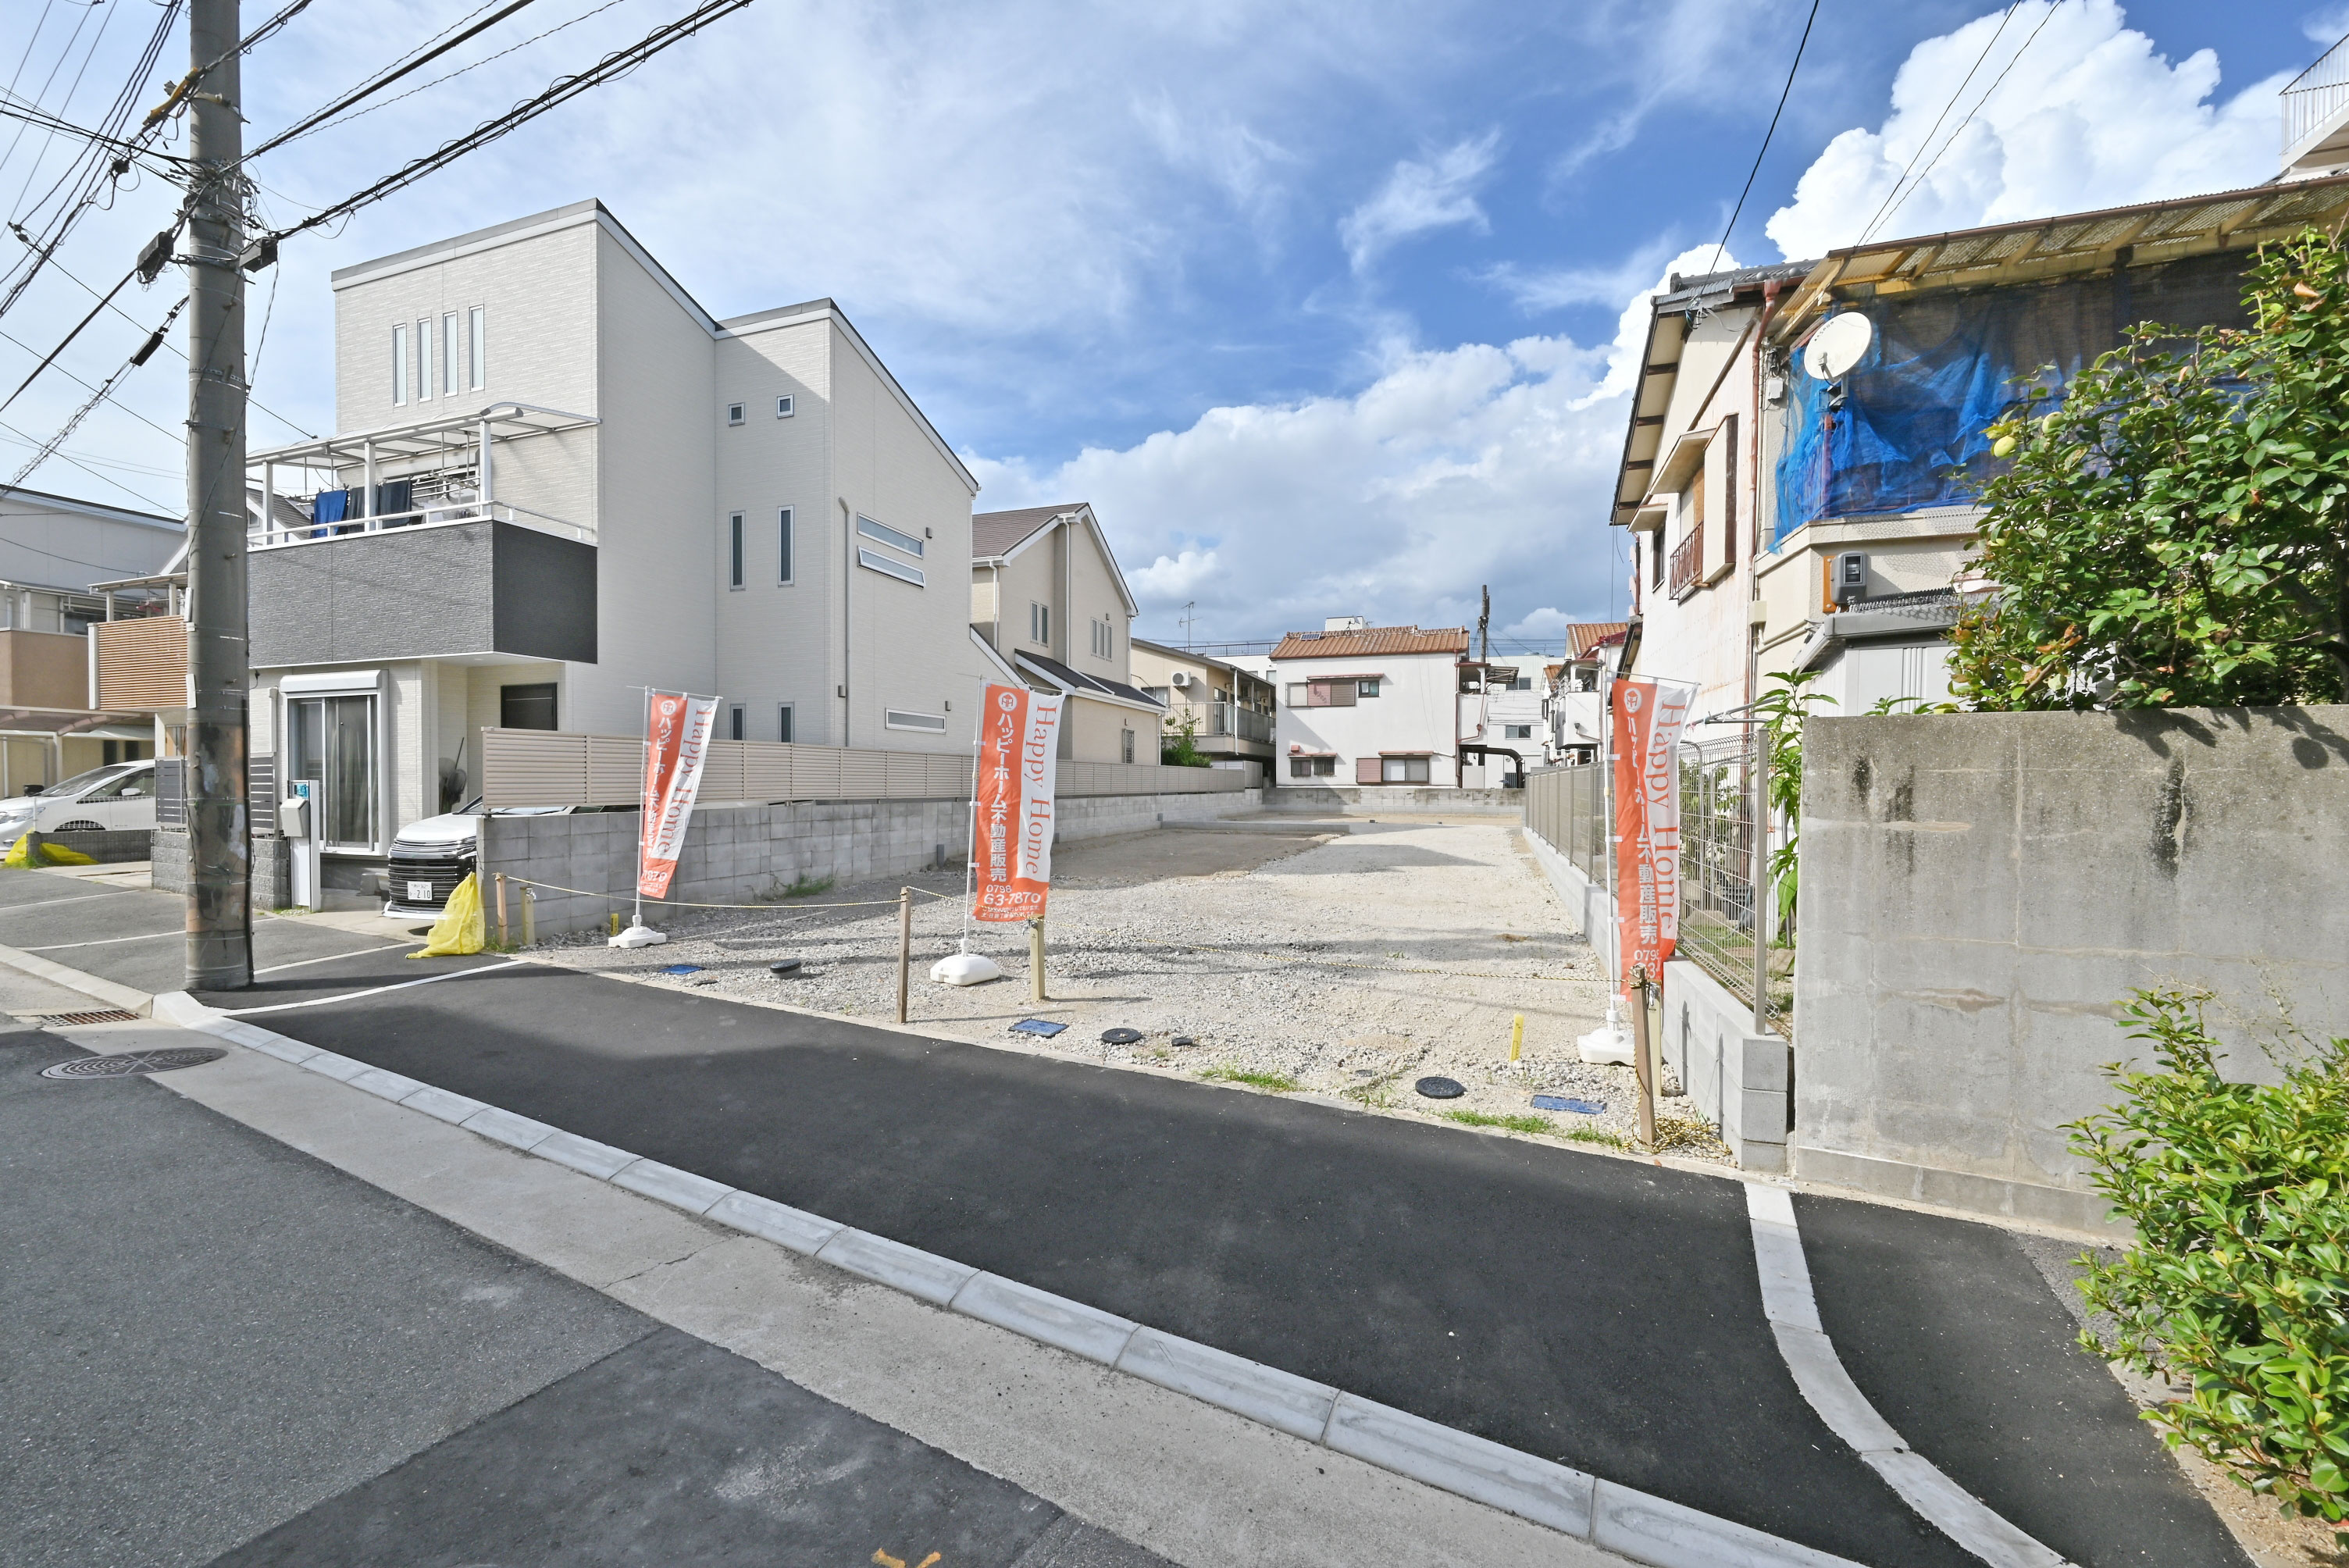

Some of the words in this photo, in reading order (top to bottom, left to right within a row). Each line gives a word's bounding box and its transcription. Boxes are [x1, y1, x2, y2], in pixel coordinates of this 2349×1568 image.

[678, 709, 712, 779] Happy
[1025, 704, 1057, 788] Happy
[1646, 700, 1688, 809] Happy
[658, 786, 693, 853] Home
[989, 713, 1014, 882] ハッピーホーム不動産販売
[1025, 796, 1050, 874] Home
[984, 892, 1041, 906] 63-7870
[986, 884, 1012, 893] 0798
[1653, 825, 1678, 929] Home
